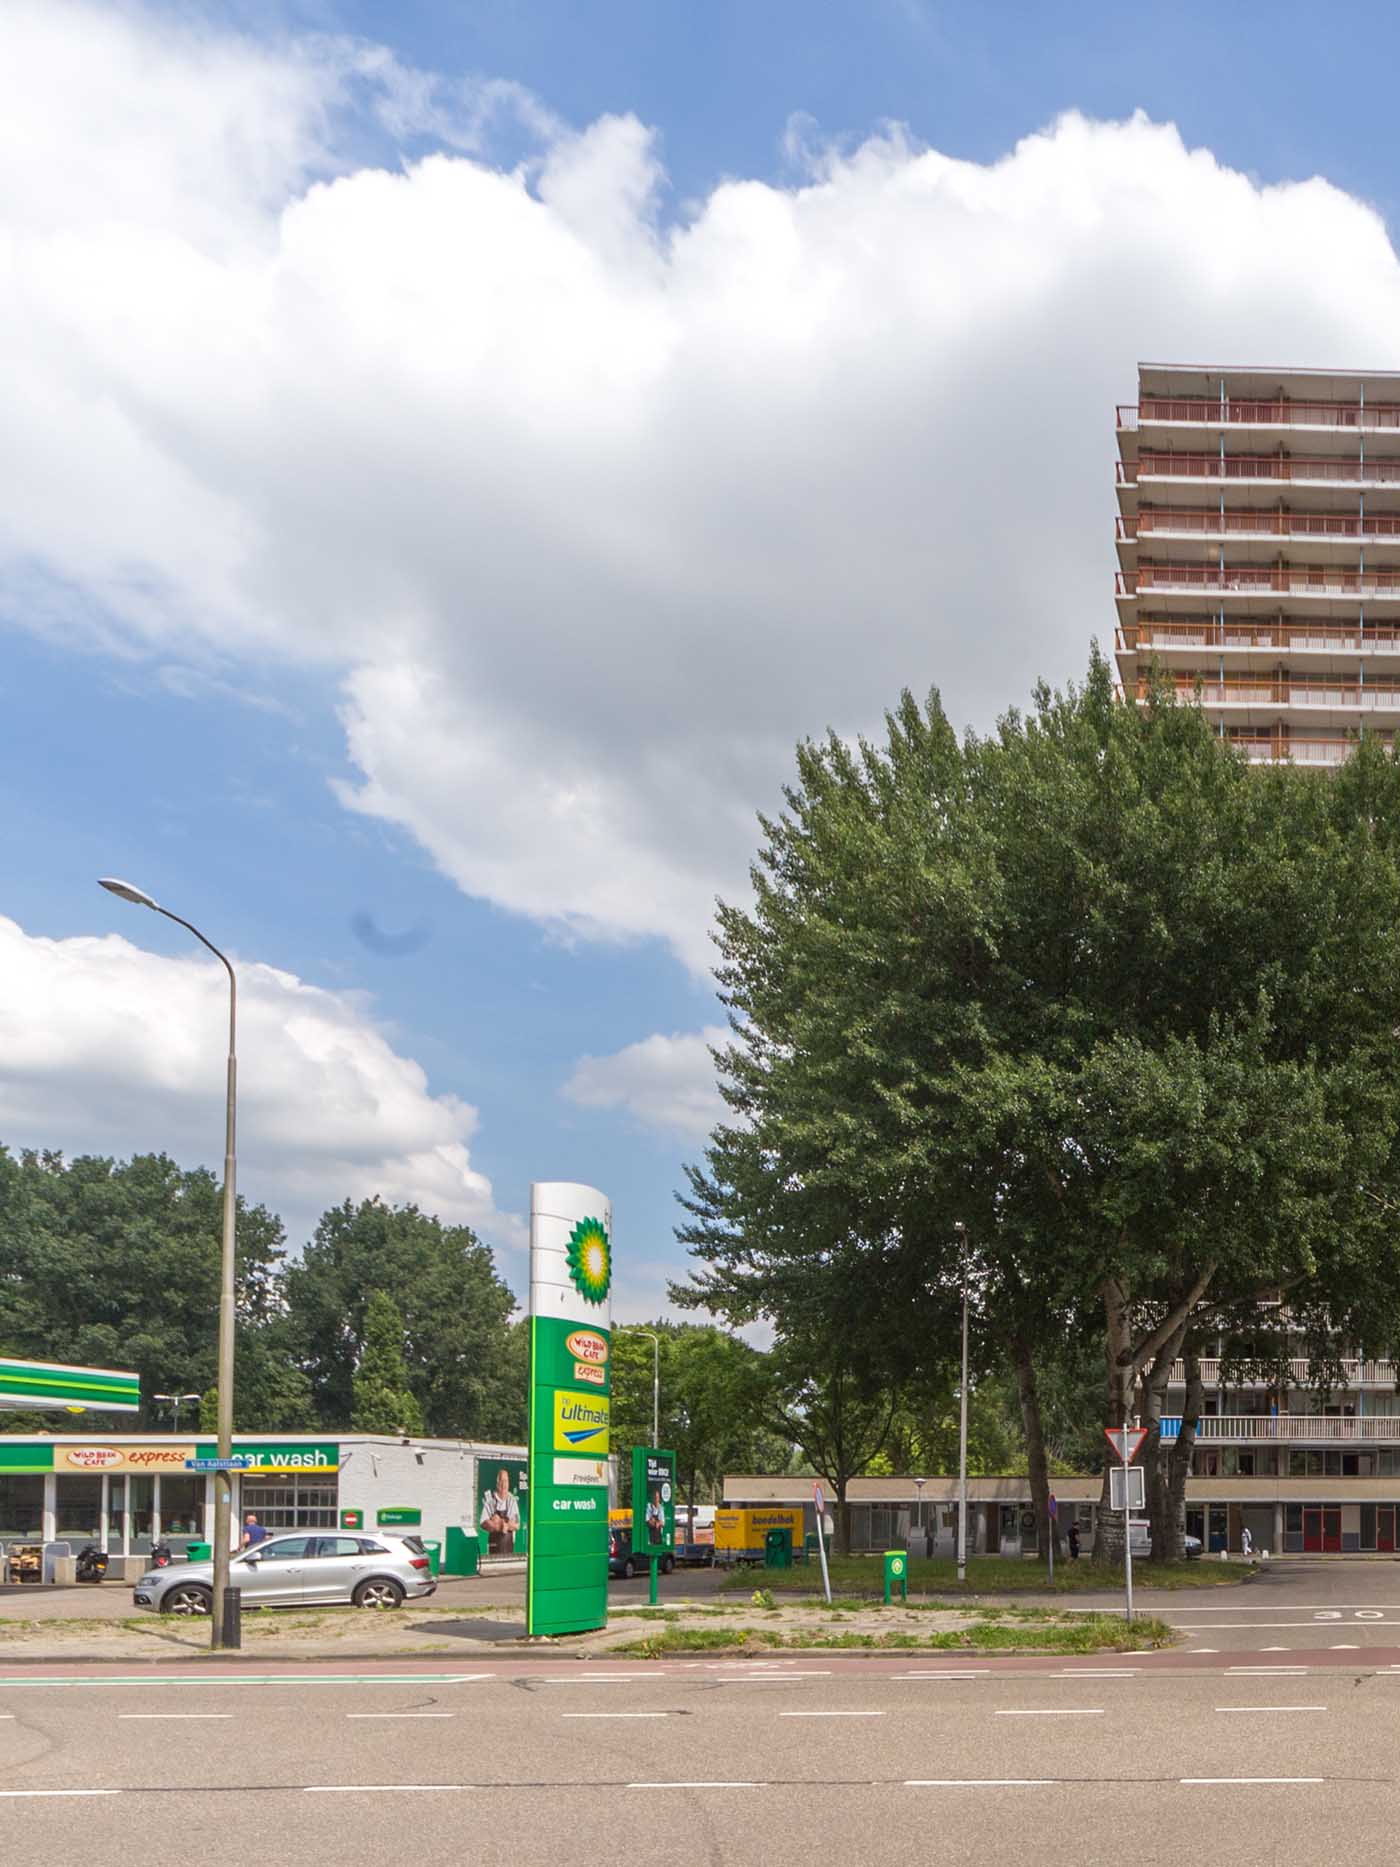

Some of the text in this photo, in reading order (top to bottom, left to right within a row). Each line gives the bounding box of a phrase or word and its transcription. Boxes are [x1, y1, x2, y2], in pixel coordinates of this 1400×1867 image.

[561, 1403, 608, 1425] ultimate
[128, 1451, 186, 1466] express
[270, 1449, 328, 1467] wash
[552, 1497, 597, 1510] car wash
